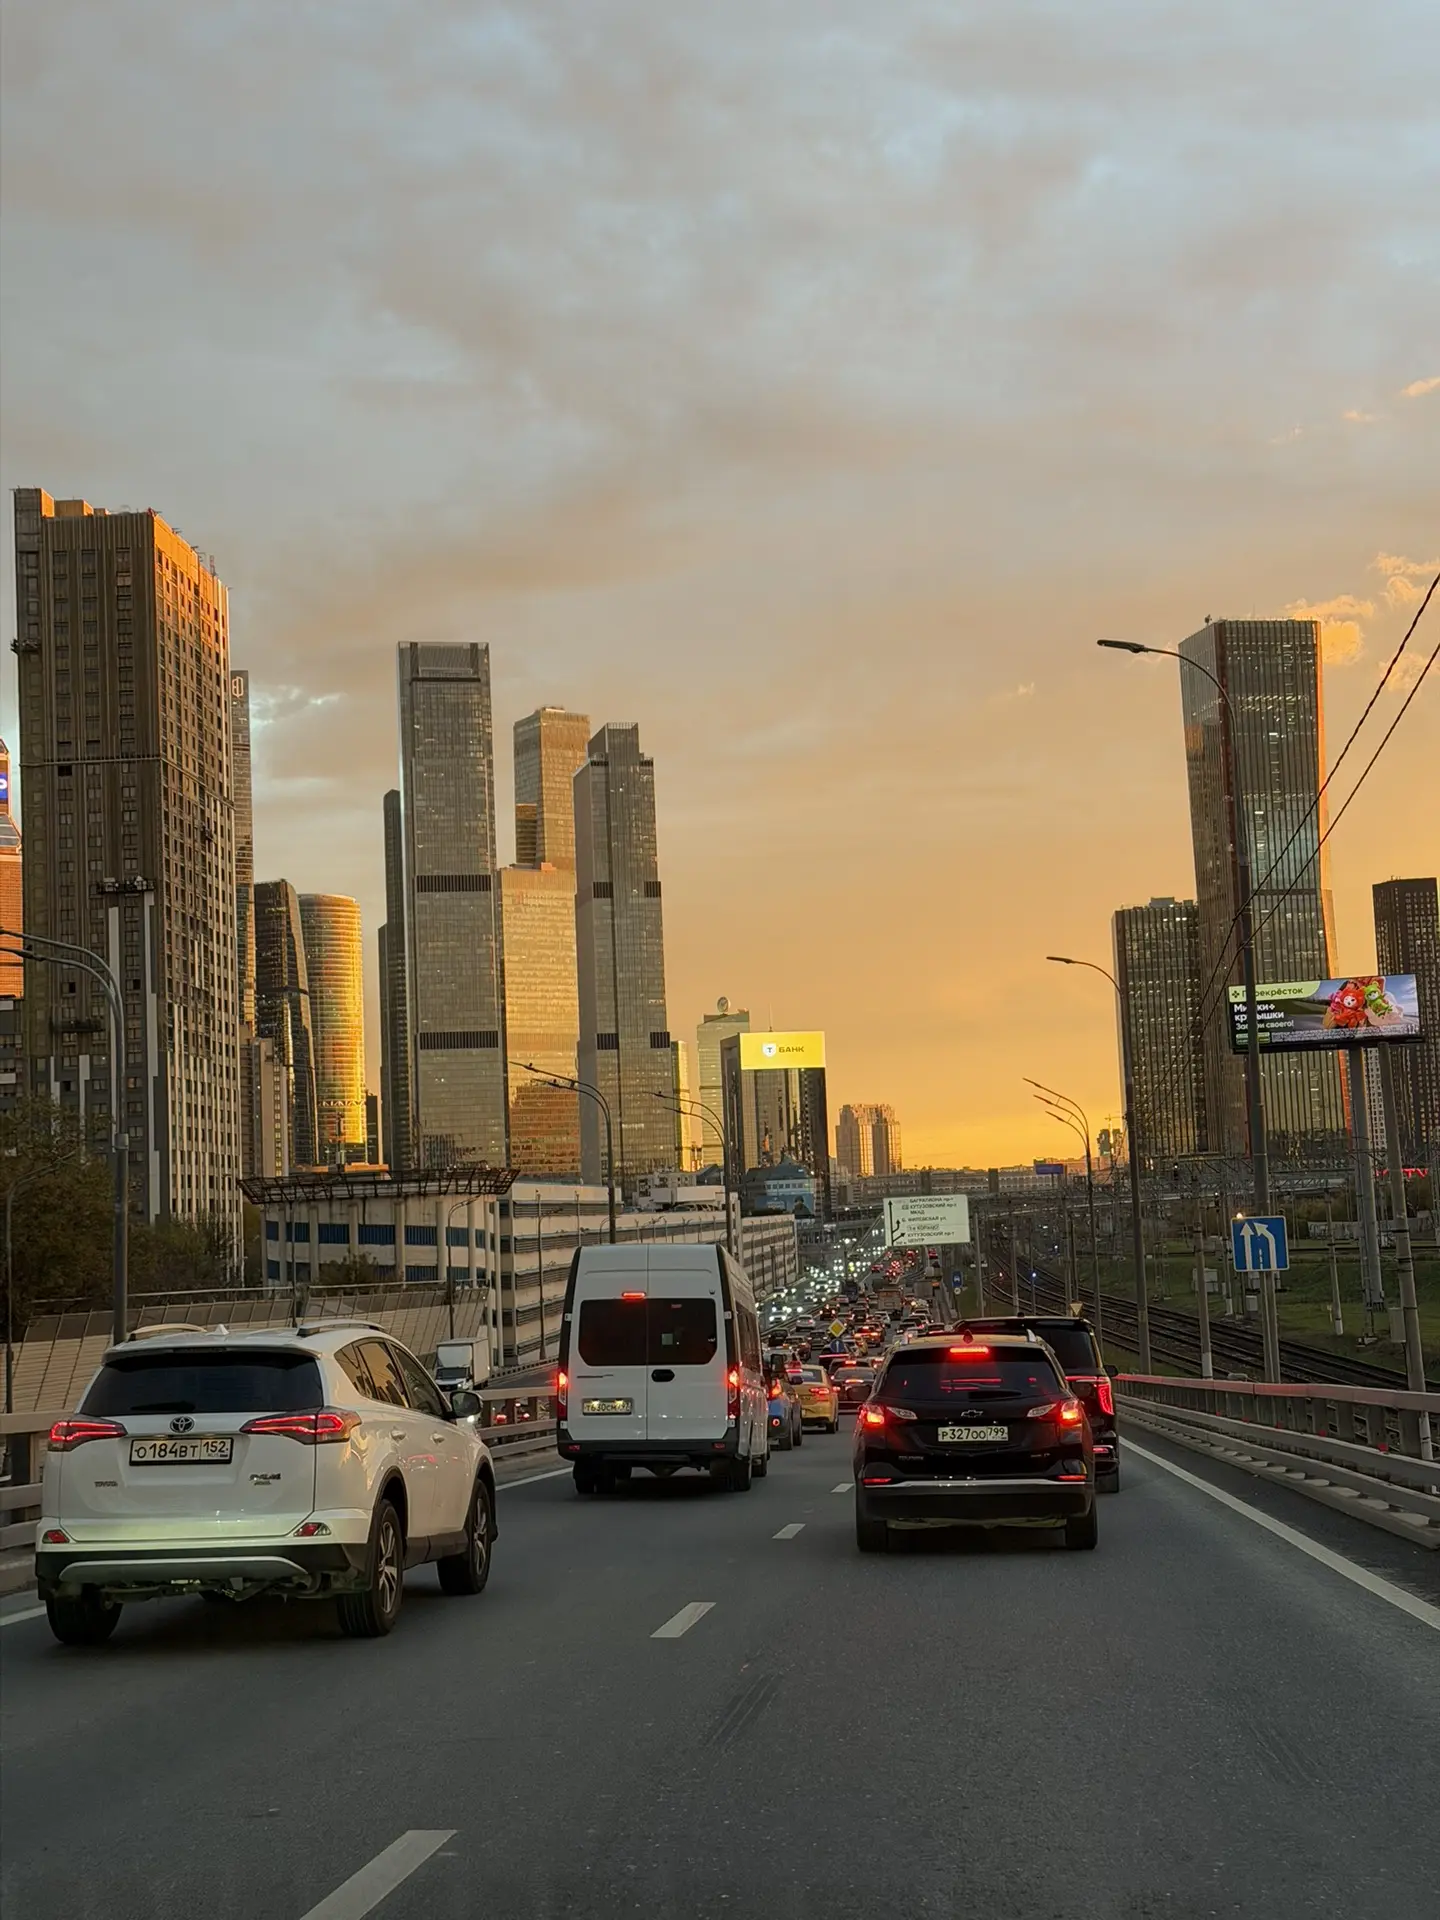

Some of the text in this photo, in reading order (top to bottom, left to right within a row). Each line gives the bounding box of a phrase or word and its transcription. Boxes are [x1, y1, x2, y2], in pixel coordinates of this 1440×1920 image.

[988, 1427, 1005, 1437] 799
[137, 1440, 226, 1459] О184ВТ 152
